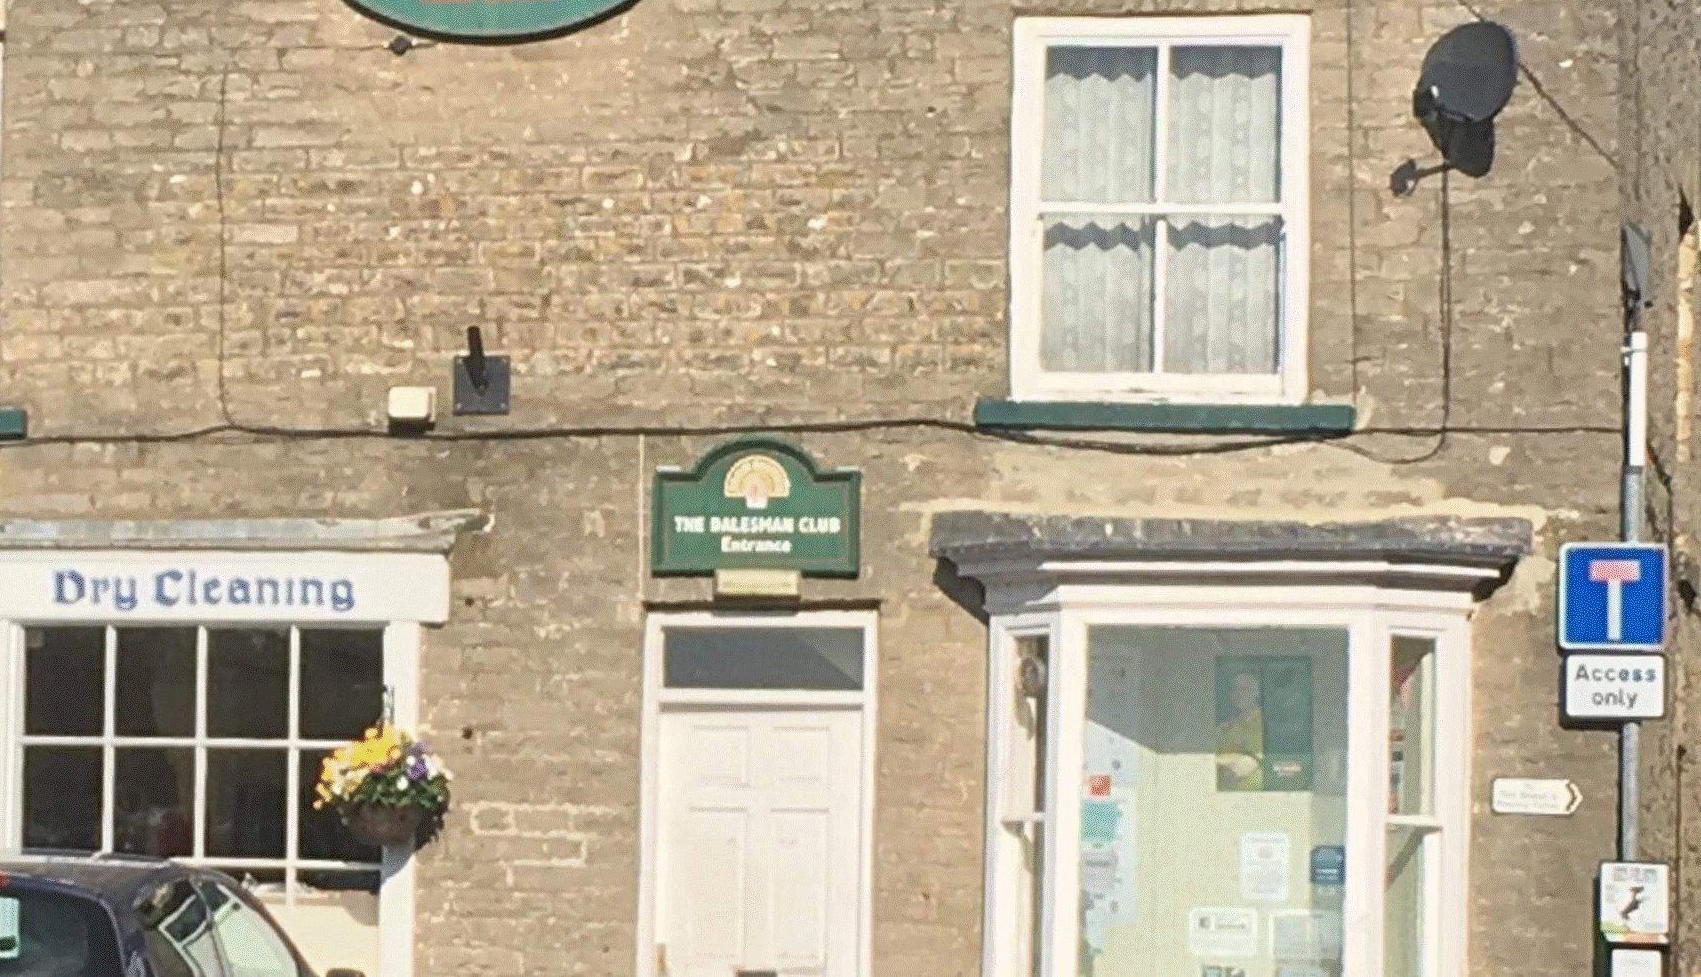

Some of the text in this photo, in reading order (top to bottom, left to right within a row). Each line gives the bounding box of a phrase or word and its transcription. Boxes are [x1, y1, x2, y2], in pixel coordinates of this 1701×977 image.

[674, 516, 842, 534] THE DALESMAN CLUB
[720, 535, 793, 554] Entrance
[52, 567, 356, 612] Dry Cleaning
[1574, 663, 1658, 683] Access
[1590, 686, 1639, 711] only
